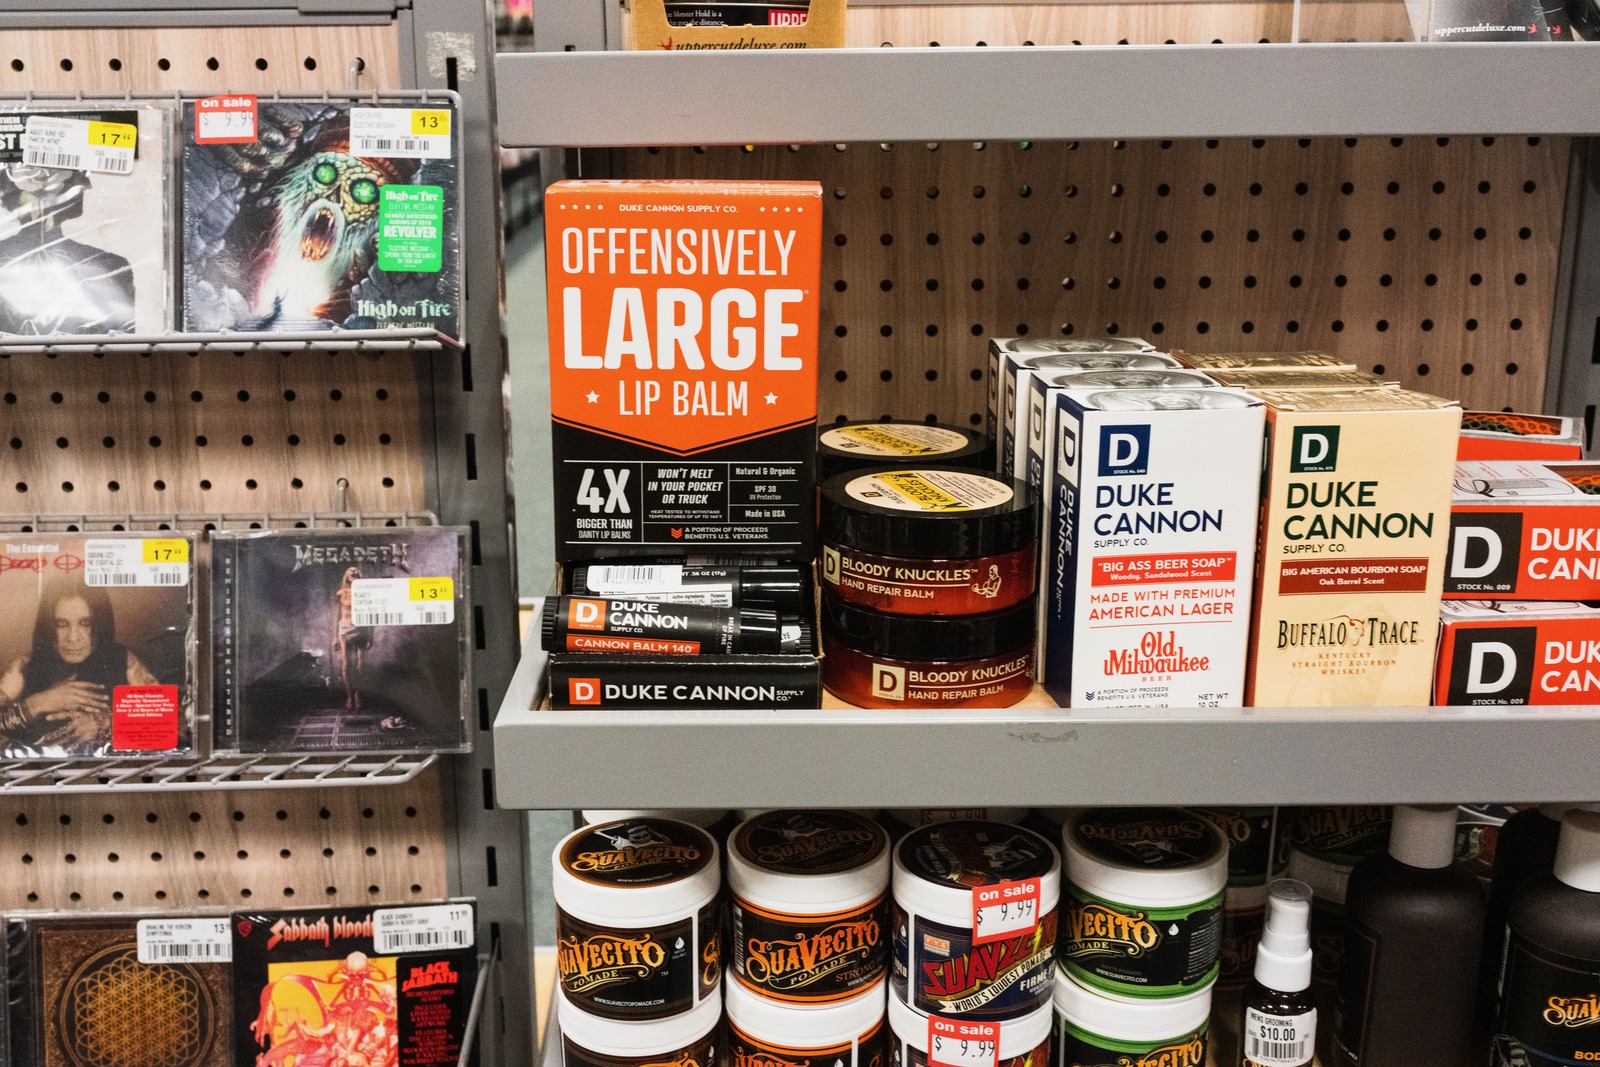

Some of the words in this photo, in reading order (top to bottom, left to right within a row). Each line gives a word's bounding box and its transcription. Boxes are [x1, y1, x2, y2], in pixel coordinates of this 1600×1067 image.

[695, 10, 710, 18] Hold
[711, 10, 717, 18] is
[1434, 22, 1526, 36] uppercutdeluxe.com
[201, 99, 219, 108] on
[222, 97, 252, 108] sale
[419, 116, 438, 128] 13
[100, 133, 121, 145] 17
[385, 190, 408, 202] High
[418, 190, 438, 202] Fire
[620, 204, 642, 212] DUKE
[646, 204, 684, 212] CANNON
[687, 205, 721, 213] SUPPLY
[384, 225, 437, 239] REVOLVER
[562, 227, 796, 276] OFFENSIVELY
[356, 300, 398, 320] High
[400, 306, 416, 316] on
[414, 298, 451, 318] Fire
[619, 380, 661, 416] LIP
[673, 380, 748, 416] BALM
[1108, 433, 1140, 467] D
[1300, 433, 1329, 464] D
[658, 468, 688, 479] WON'T
[690, 468, 714, 479] MELT
[736, 466, 762, 475] Natural
[763, 467, 768, 475] &
[770, 467, 796, 477] Organic
[576, 468, 631, 514] 4X
[648, 482, 658, 492] IN
[660, 482, 686, 492] YOUR
[688, 482, 723, 492] POCKET
[894, 480, 932, 506] BLOODY
[906, 478, 951, 503] KNUCKLES
[1096, 482, 1174, 509] DUKE
[1286, 481, 1378, 509] DUKE
[662, 494, 676, 504] OR
[678, 494, 708, 504] TRUCK
[745, 510, 762, 518] Made
[772, 510, 786, 518] USA
[1094, 509, 1224, 536] CANNON
[576, 518, 608, 529] BIGGER
[610, 518, 633, 530] THAN
[1284, 512, 1434, 540] CANNON
[610, 531, 632, 539] BALMS
[1094, 538, 1130, 548] SUPPLY
[1134, 538, 1150, 546] CO.
[154, 549, 172, 560] 17
[1284, 544, 1324, 554] SUPPLY
[1328, 544, 1346, 553] CO.
[1450, 526, 1503, 578] D
[292, 543, 410, 574] MEGADETH
[826, 552, 836, 575] D
[842, 556, 891, 578] BLOODY
[1128, 560, 1151, 570] ASS
[1155, 558, 1188, 570] BEER
[1144, 571, 1188, 580] Sandalwood
[1282, 568, 1298, 576] BIG
[1300, 566, 1349, 576] AMERICAN
[1350, 566, 1398, 574] BOURBON
[842, 576, 865, 590] HAND
[867, 580, 901, 597] REPAIR
[904, 588, 934, 599] BALM
[1319, 578, 1335, 586] Oak
[420, 588, 438, 599] 13
[1090, 592, 1128, 604] MADE
[1134, 590, 1169, 602] WITH
[1174, 588, 1235, 599] PREMIUM
[575, 602, 599, 624] D
[611, 601, 659, 614] DUKE
[1089, 604, 1174, 620] AMERICAN
[1180, 602, 1234, 616] LAGER
[610, 612, 688, 630] CANNON
[610, 626, 633, 634] SUPPLY
[1278, 620, 1348, 649] BUFFALO
[1368, 618, 1419, 646] TRACE
[575, 638, 630, 650] CANNON
[634, 641, 669, 652] BALM
[1140, 631, 1178, 658] Old
[1104, 646, 1210, 676] Milwaukee
[1292, 660, 1344, 668] STRAIGHT
[1318, 652, 1372, 660] KENTUCKY
[908, 670, 968, 683] BLOODY
[1466, 642, 1518, 694] D
[879, 670, 898, 692] D
[576, 682, 594, 700] D
[605, 685, 667, 700] DUKE
[672, 686, 776, 701] CANNON
[908, 691, 939, 700] HAND
[942, 688, 977, 700] REPAIR
[980, 684, 1004, 698] BALM
[570, 844, 701, 871] SUAVECITO
[979, 889, 999, 901] on
[1004, 883, 1034, 898] sale
[450, 911, 460, 920] 11
[976, 907, 984, 926] $
[1000, 898, 1033, 922] 9.99
[214, 924, 225, 934] 13
[267, 916, 330, 950] Sabbath
[333, 914, 374, 940] blood
[746, 914, 881, 983] SUAVECITO
[410, 961, 450, 979] BLACK
[573, 969, 619, 988] POMADE
[790, 956, 847, 985] POMADE
[836, 962, 872, 982] STRONG
[402, 972, 458, 992] SABBATH
[953, 991, 989, 1012] WORLD'S
[991, 968, 1019, 996] LOUDEST
[1020, 950, 1047, 974] POMADE
[1020, 972, 1048, 991] FIRME
[1250, 1012, 1264, 1023] MENS
[1265, 1018, 1293, 1026] GROOMING
[934, 1022, 954, 1032] on
[960, 1024, 994, 1036] sale
[1260, 1025, 1296, 1041] $10.00
[935, 1035, 942, 1051] $
[960, 1040, 996, 1058] 9.99
